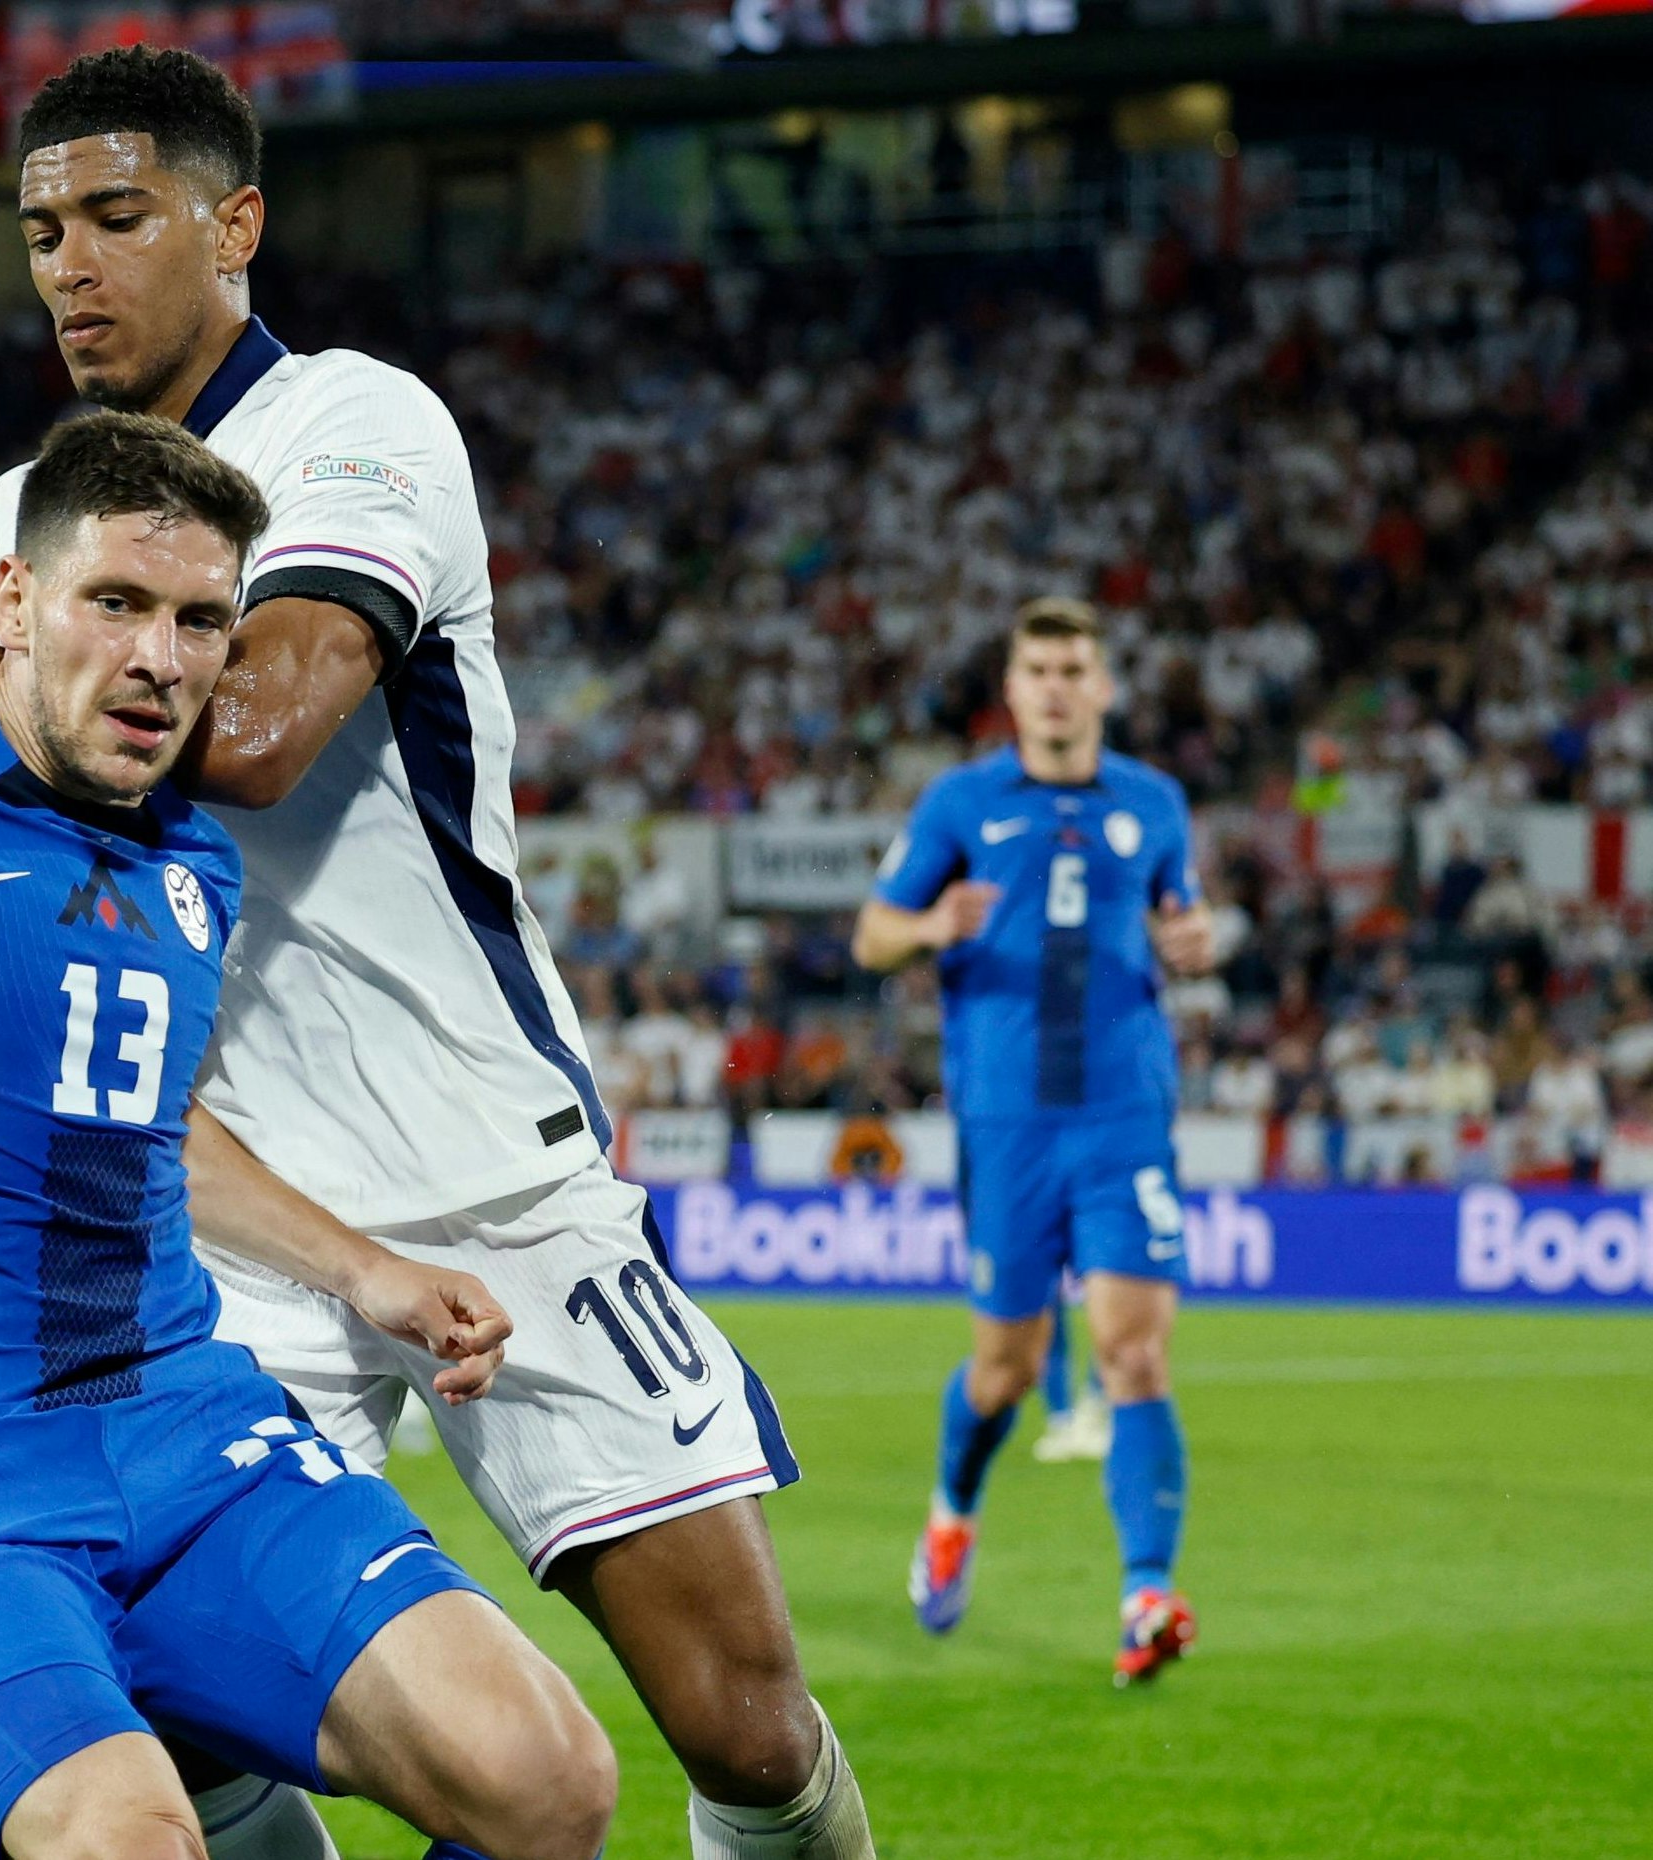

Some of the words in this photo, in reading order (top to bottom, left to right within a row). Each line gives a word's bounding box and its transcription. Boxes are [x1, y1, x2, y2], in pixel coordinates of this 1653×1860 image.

[302, 461, 419, 497] FOUNDATION
[303, 453, 331, 466] UEFA
[1046, 853, 1088, 928] 6
[52, 962, 171, 1125] 13
[1456, 1182, 1653, 1296] Boo
[565, 1259, 711, 1399] 10
